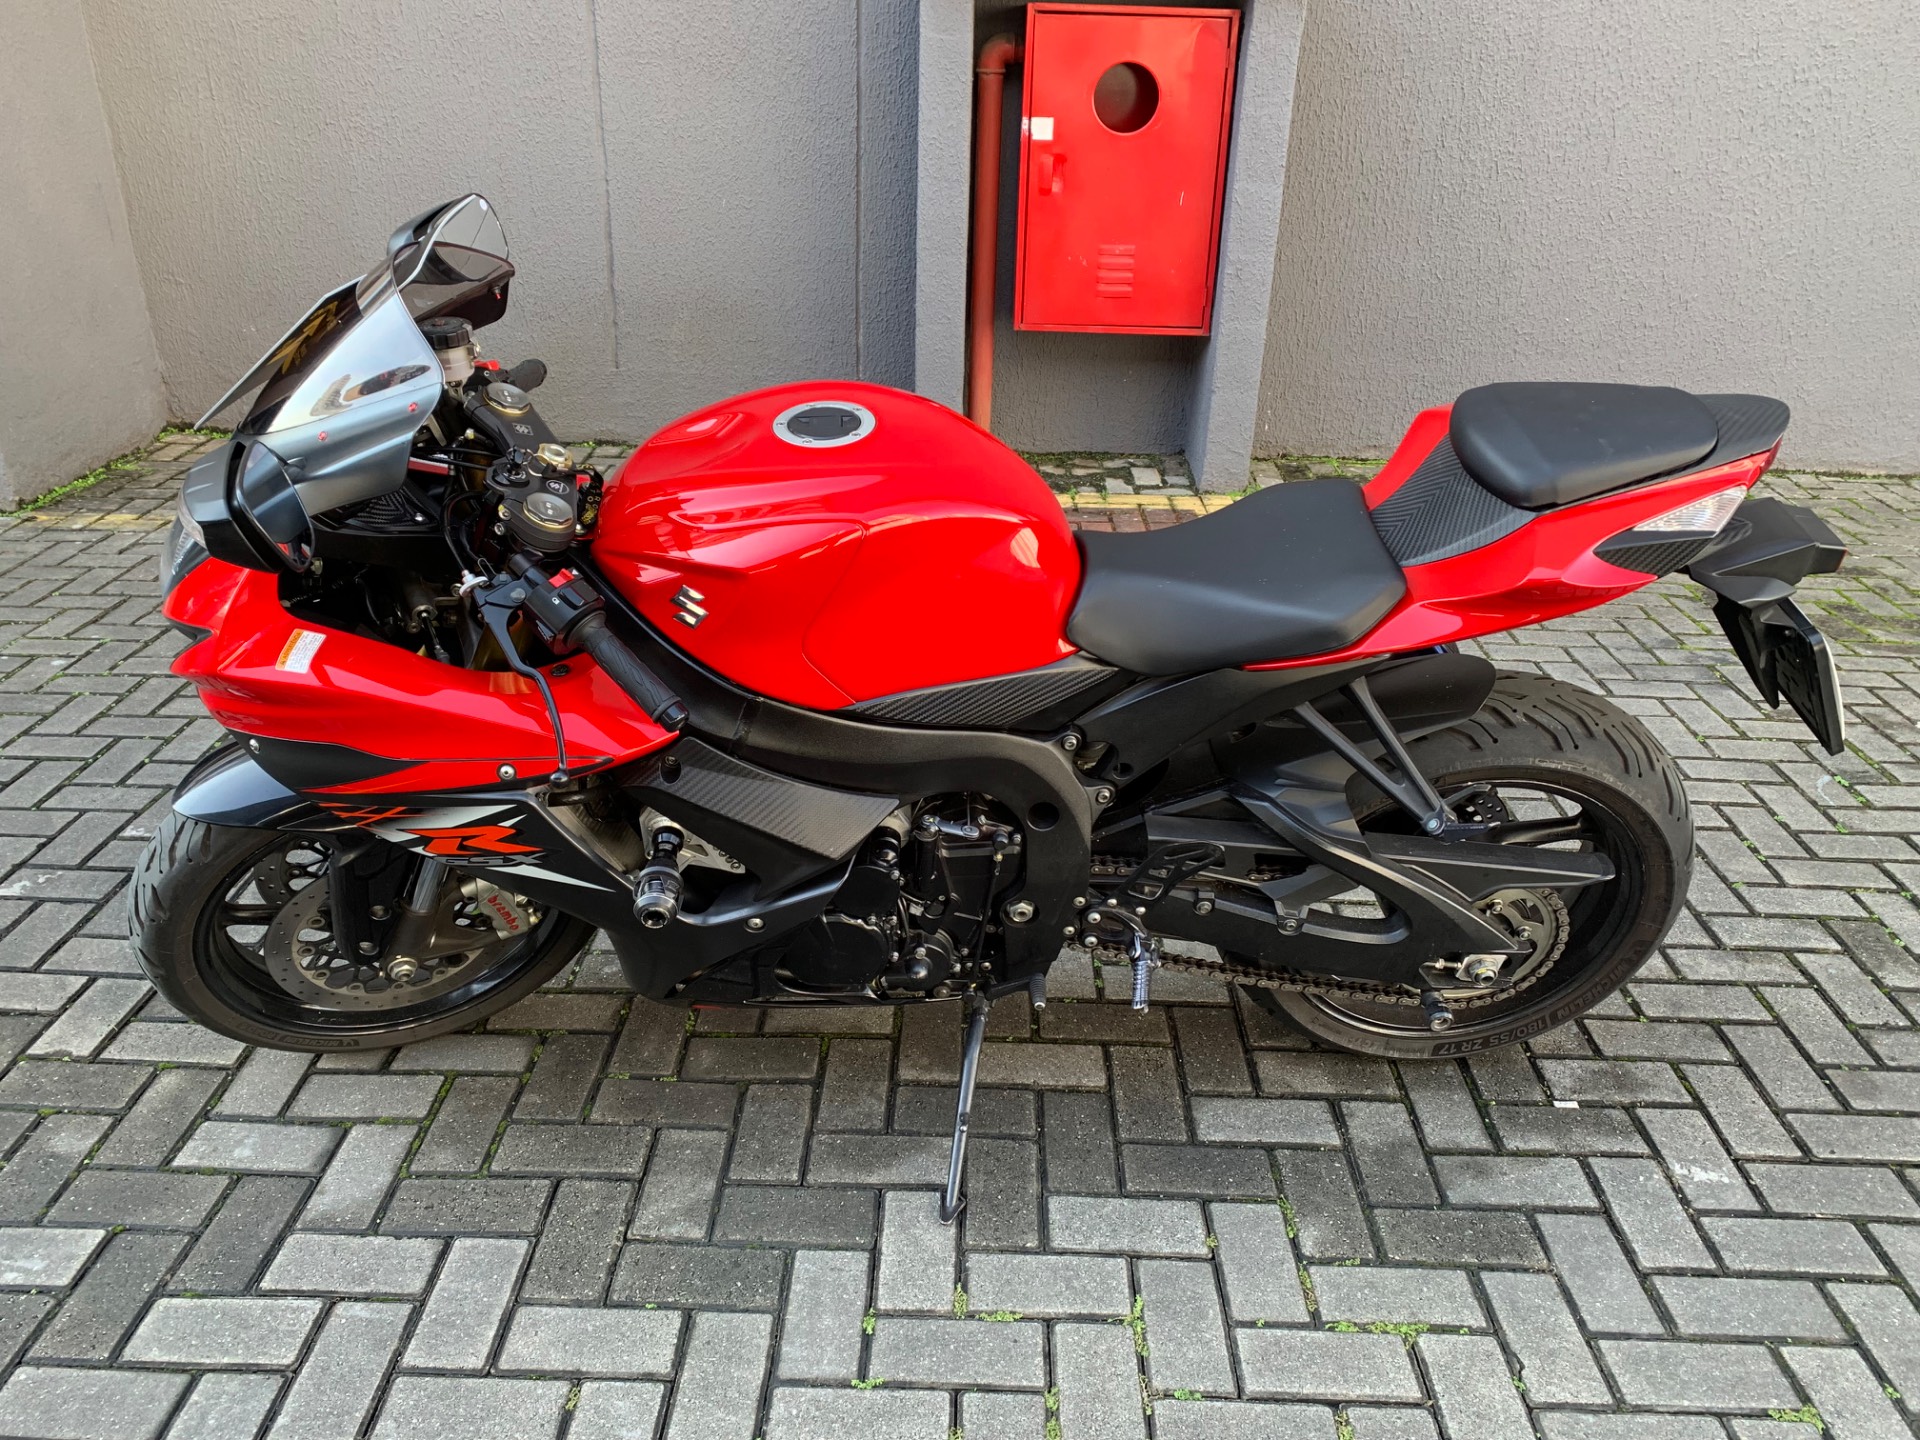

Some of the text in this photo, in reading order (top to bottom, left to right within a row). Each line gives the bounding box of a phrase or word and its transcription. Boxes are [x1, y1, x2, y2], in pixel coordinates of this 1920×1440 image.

[487, 894, 519, 931] brembo
[1556, 963, 1629, 1021] MICHELIN
[283, 1035, 340, 1047] MICHELIN
[1438, 1018, 1546, 1055] 180/55 ZR 17
